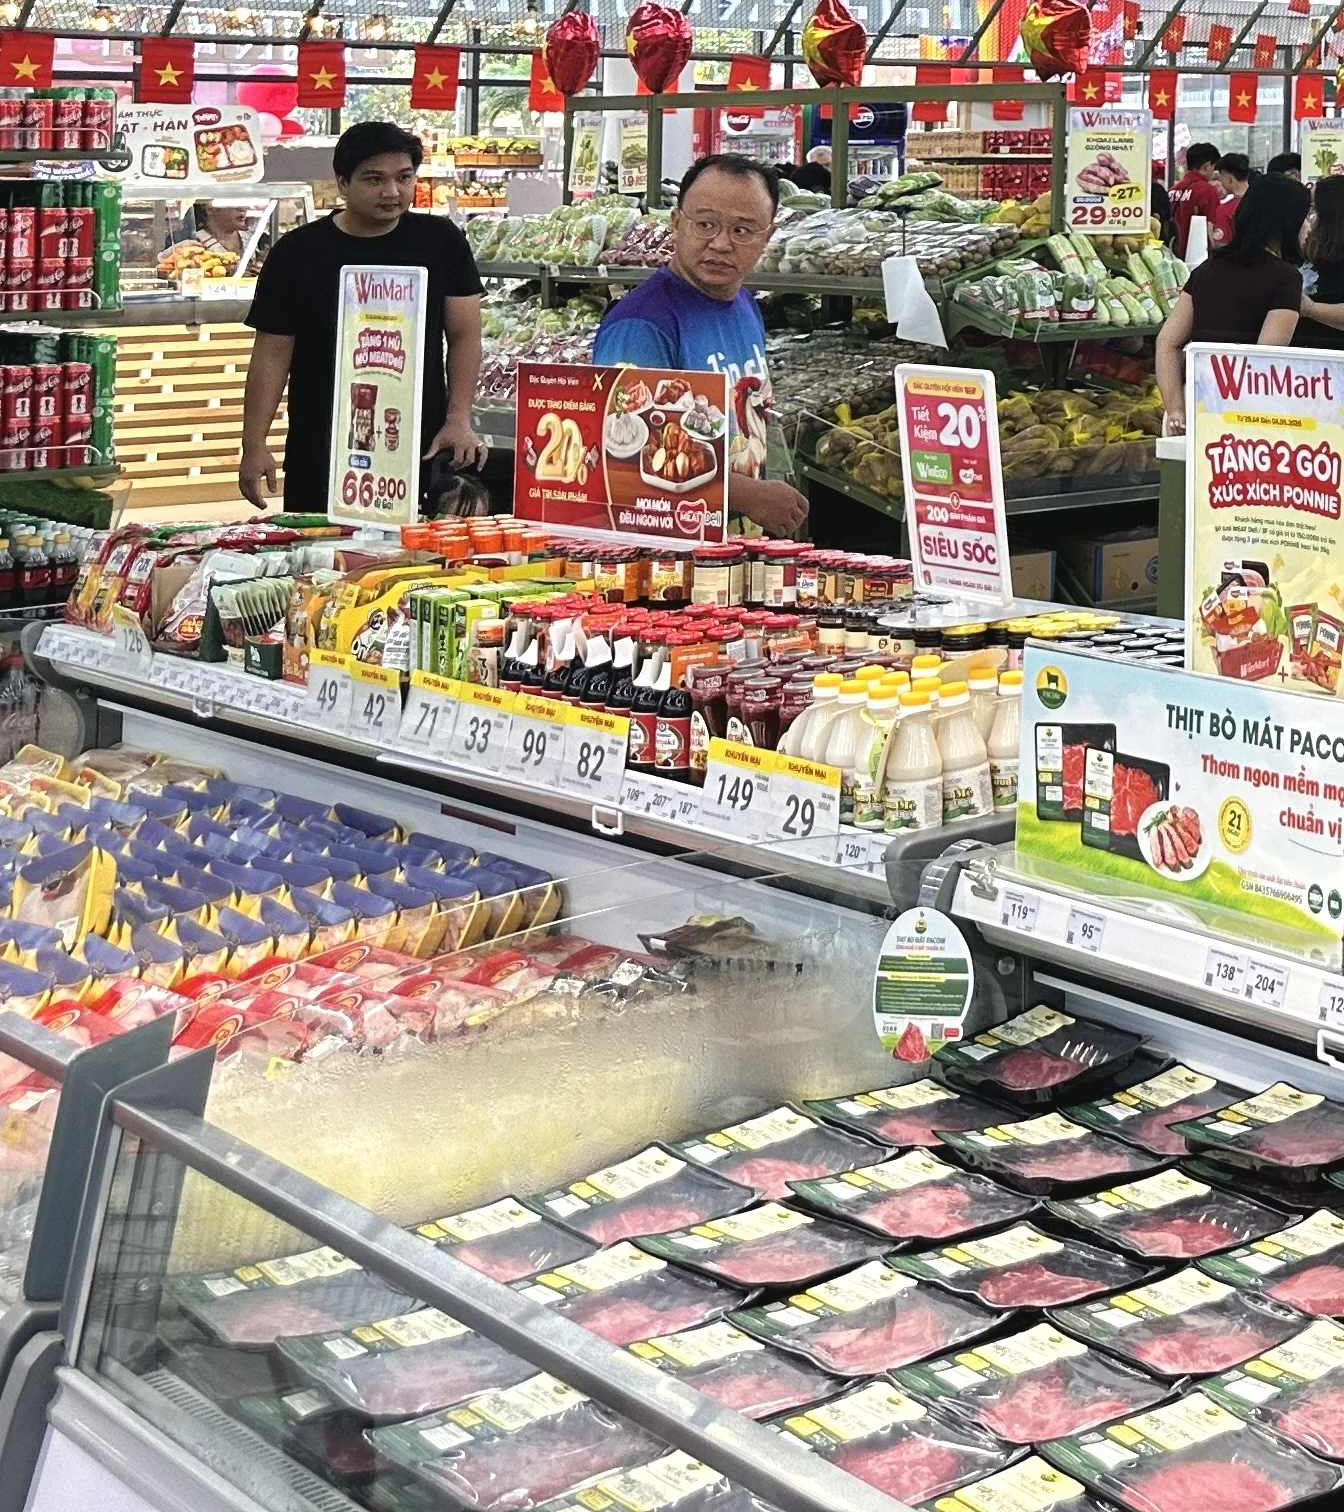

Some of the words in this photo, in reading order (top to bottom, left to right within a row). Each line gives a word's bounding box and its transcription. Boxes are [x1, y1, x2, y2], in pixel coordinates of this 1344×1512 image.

[1080, 111, 1143, 128] WinMart
[354, 272, 415, 305] WinMart
[1210, 354, 1334, 402] WinMart
[911, 405, 931, 422] Tiết
[937, 402, 980, 449] 20
[914, 424, 938, 443] Kiệm
[1209, 438, 1271, 479] TẶNG
[1277, 446, 1290, 474] 2
[1296, 446, 1338, 485] GÓI
[342, 469, 407, 508] 66.900
[1212, 480, 1243, 503] XÚC
[1246, 478, 1280, 501] XÍCH
[1284, 485, 1337, 513] PONNIE
[926, 505, 949, 523] 200
[923, 531, 959, 559] SIÊU
[962, 536, 997, 565] SỐC
[317, 679, 338, 712] 49
[363, 693, 386, 727] 42
[464, 717, 491, 753] 33
[1166, 704, 1202, 743] THỊT
[1209, 709, 1237, 740] BÒ
[1242, 714, 1284, 750] MÁT
[521, 729, 547, 766] 99
[577, 741, 606, 781] 82
[717, 774, 754, 811] 149
[1200, 754, 1240, 780] Thơm
[1243, 763, 1280, 790] ngon
[1283, 764, 1319, 797] mềm
[782, 794, 815, 836] 29
[1228, 809, 1243, 831] 21
[1279, 801, 1324, 836] chuẩn
[1327, 817, 1343, 845] vị
[1081, 922, 1096, 940] 95
[1215, 961, 1235, 981] 138
